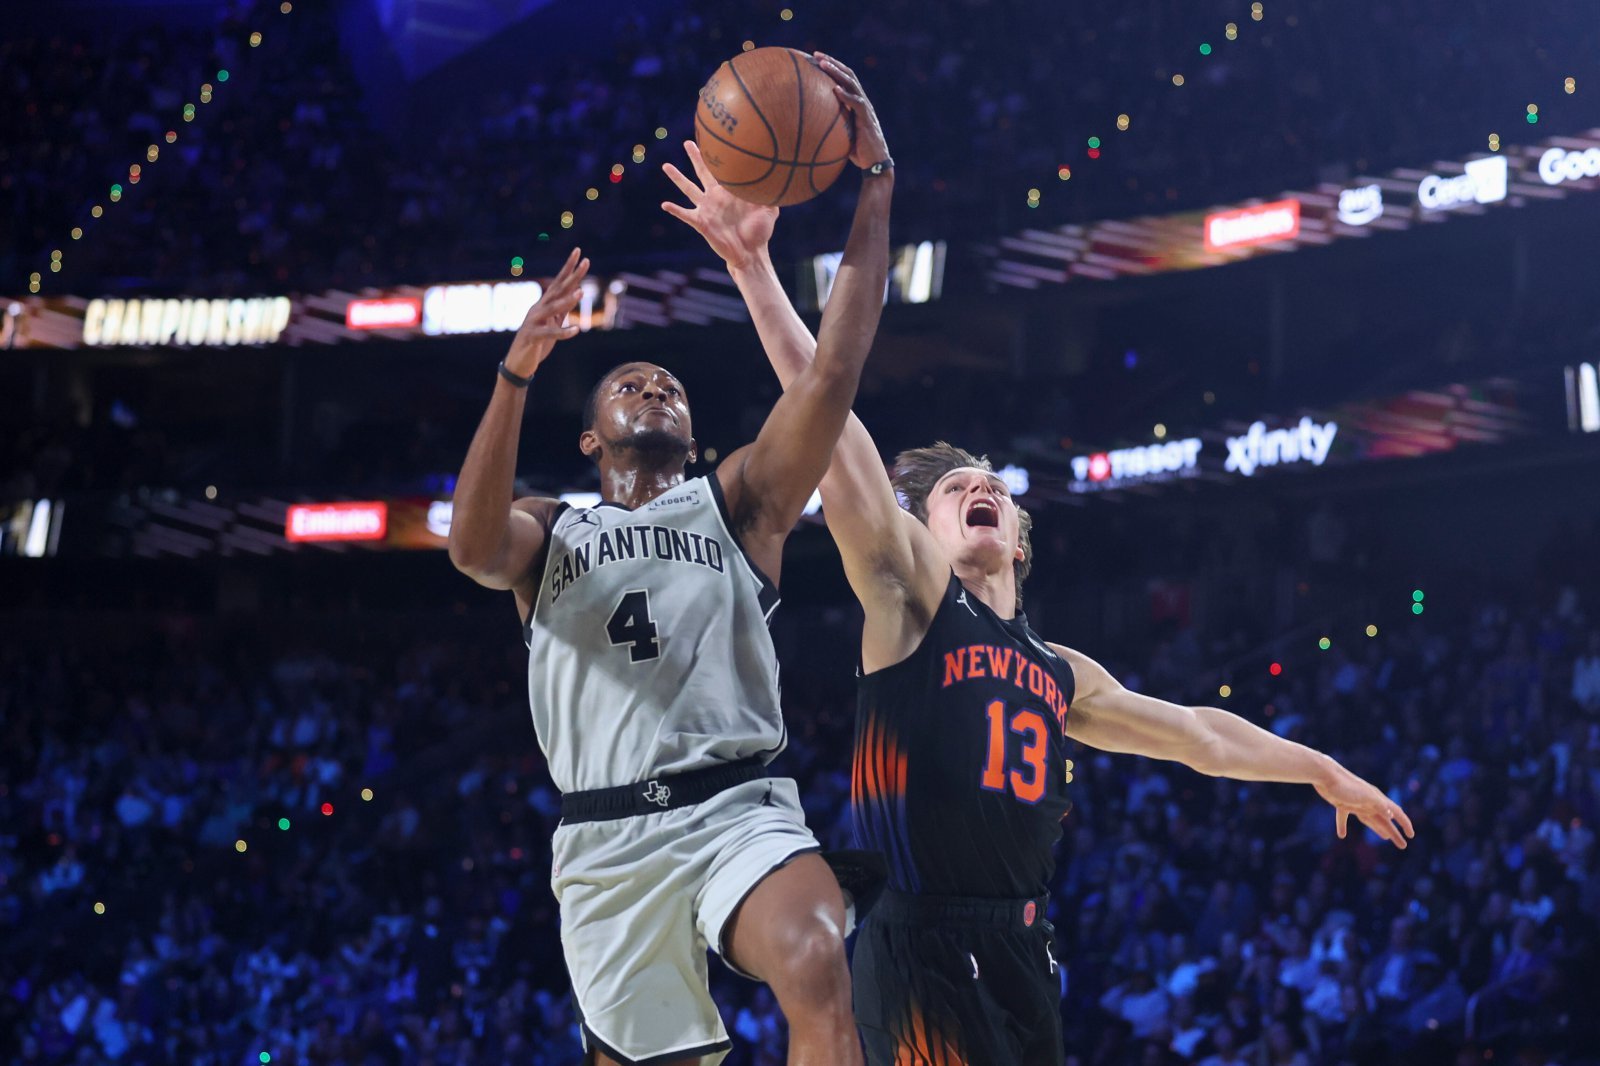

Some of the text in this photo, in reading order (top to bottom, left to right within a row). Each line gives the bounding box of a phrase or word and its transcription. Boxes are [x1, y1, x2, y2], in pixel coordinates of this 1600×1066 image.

[1224, 416, 1337, 477] xfinity
[654, 495, 692, 507] LEDGER
[551, 524, 725, 604] SAN ANTONIO
[604, 588, 661, 665] 4
[942, 644, 1068, 737] NEW YORK
[980, 697, 1050, 806] 13
